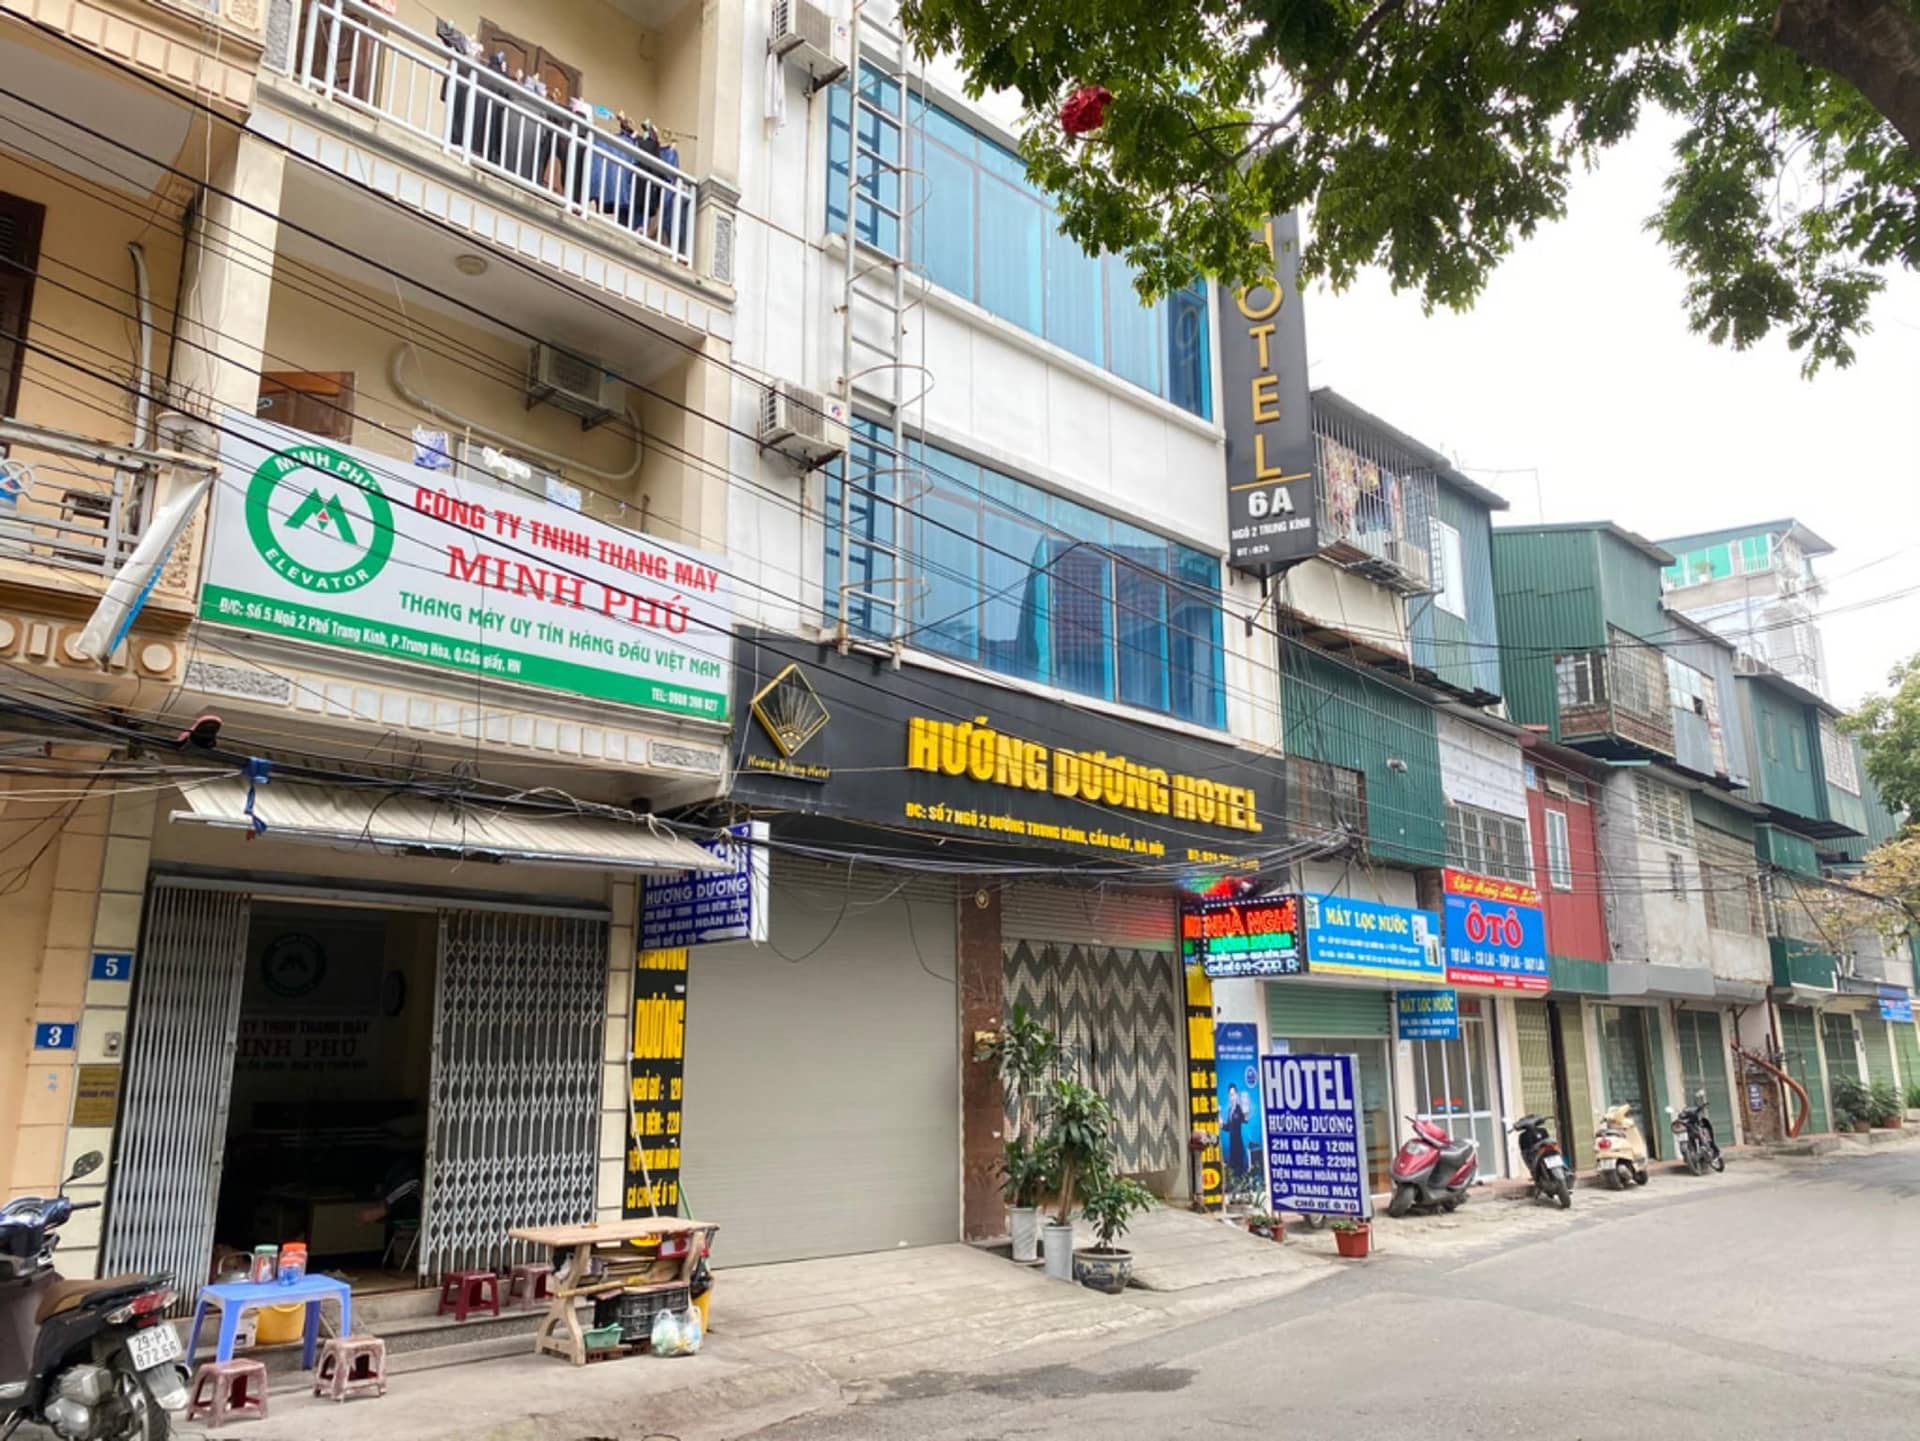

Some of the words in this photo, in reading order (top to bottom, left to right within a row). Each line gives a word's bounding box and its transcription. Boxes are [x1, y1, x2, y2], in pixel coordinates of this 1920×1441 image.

[273, 450, 330, 474] MINH
[1248, 487, 1295, 518] 6A
[415, 485, 486, 531] CÔNG
[494, 509, 522, 538] TY
[530, 520, 590, 560] TNHH
[598, 540, 668, 580] THANG
[265, 548, 369, 590] ELEVATOR
[446, 545, 587, 610] MINH
[600, 583, 691, 635] PHÚ
[246, 602, 261, 619] Số
[263, 607, 272, 621] 5
[298, 614, 307, 630] 2
[400, 591, 462, 622] THANG
[468, 607, 505, 633] MÁY
[510, 618, 532, 639] UY
[537, 621, 563, 644] TÍN
[655, 650, 685, 673] VIỆT
[689, 658, 721, 680] NAM
[907, 714, 1048, 791] HƯỚNG
[1052, 748, 1169, 815] DƯƠNG
[1172, 774, 1263, 832] HOTEL
[928, 802, 945, 821] SỐ
[945, 809, 953, 823] 7
[979, 814, 987, 829] 2
[696, 877, 748, 898] DƯƠNG
[1325, 904, 1352, 927] MÁY
[1354, 911, 1376, 935] LỌC
[1378, 914, 1408, 936] NƯỚC
[1465, 901, 1523, 948] ÔTÔ
[105, 958, 118, 977] 5
[48, 1026, 62, 1046] 3
[1263, 1059, 1352, 1110] HOTEL
[1268, 1110, 1309, 1132] HƯỚNG
[1311, 1114, 1354, 1133] DƯƠNG
[1271, 1138, 1289, 1151] 2H
[1325, 1140, 1355, 1153] 120N
[1271, 1153, 1293, 1166] QUA
[1327, 1155, 1357, 1168] 220N
[1290, 1183, 1329, 1196] THANG
[1332, 1183, 1359, 1198] MÁY
